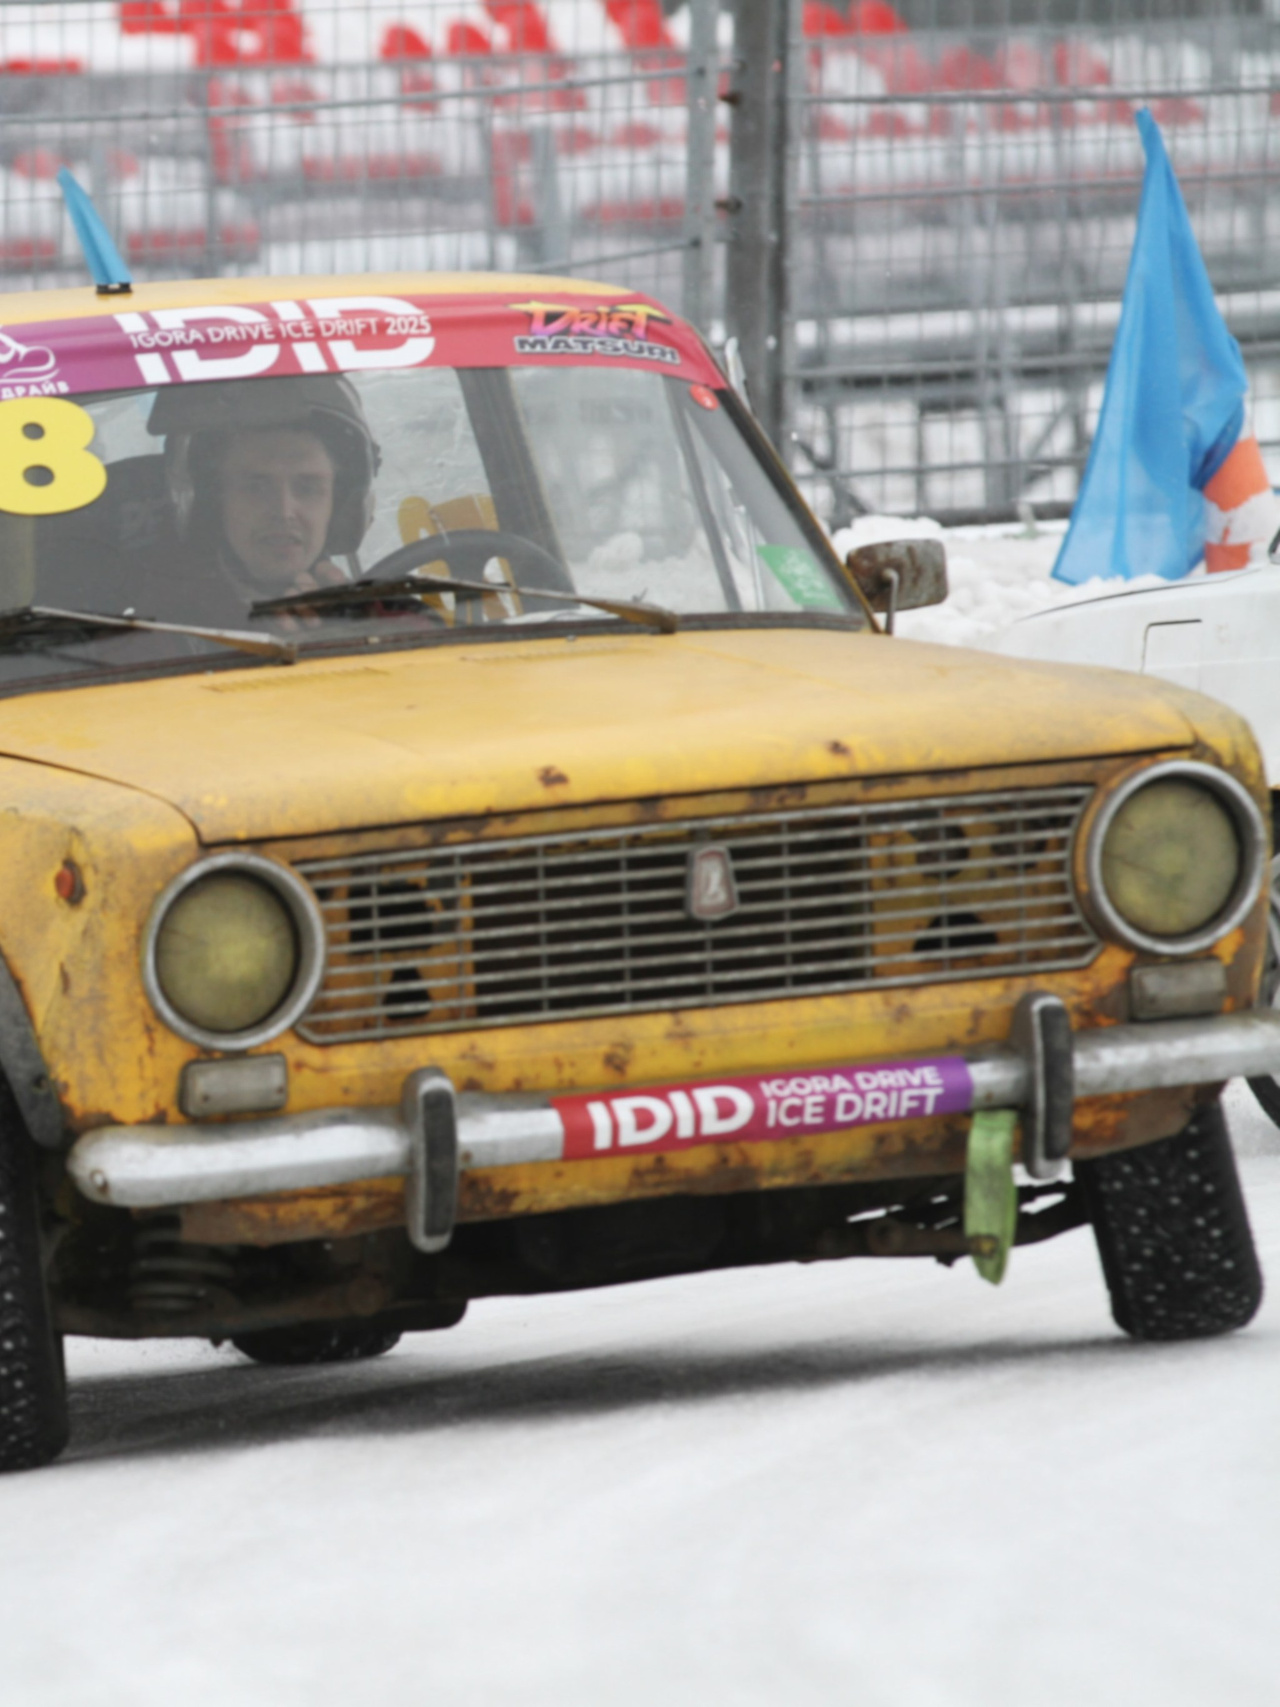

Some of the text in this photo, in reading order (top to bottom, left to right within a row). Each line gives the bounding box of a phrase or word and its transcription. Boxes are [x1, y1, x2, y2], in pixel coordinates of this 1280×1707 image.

[129, 315, 432, 349] IGORA DRIVE ICE DRIFT 2025
[1, 380, 70, 400] ДРАЙВ
[760, 1065, 943, 1099] IGORA DRIVE
[586, 1085, 755, 1150] IDID
[766, 1087, 944, 1128] ICE DRIFT
